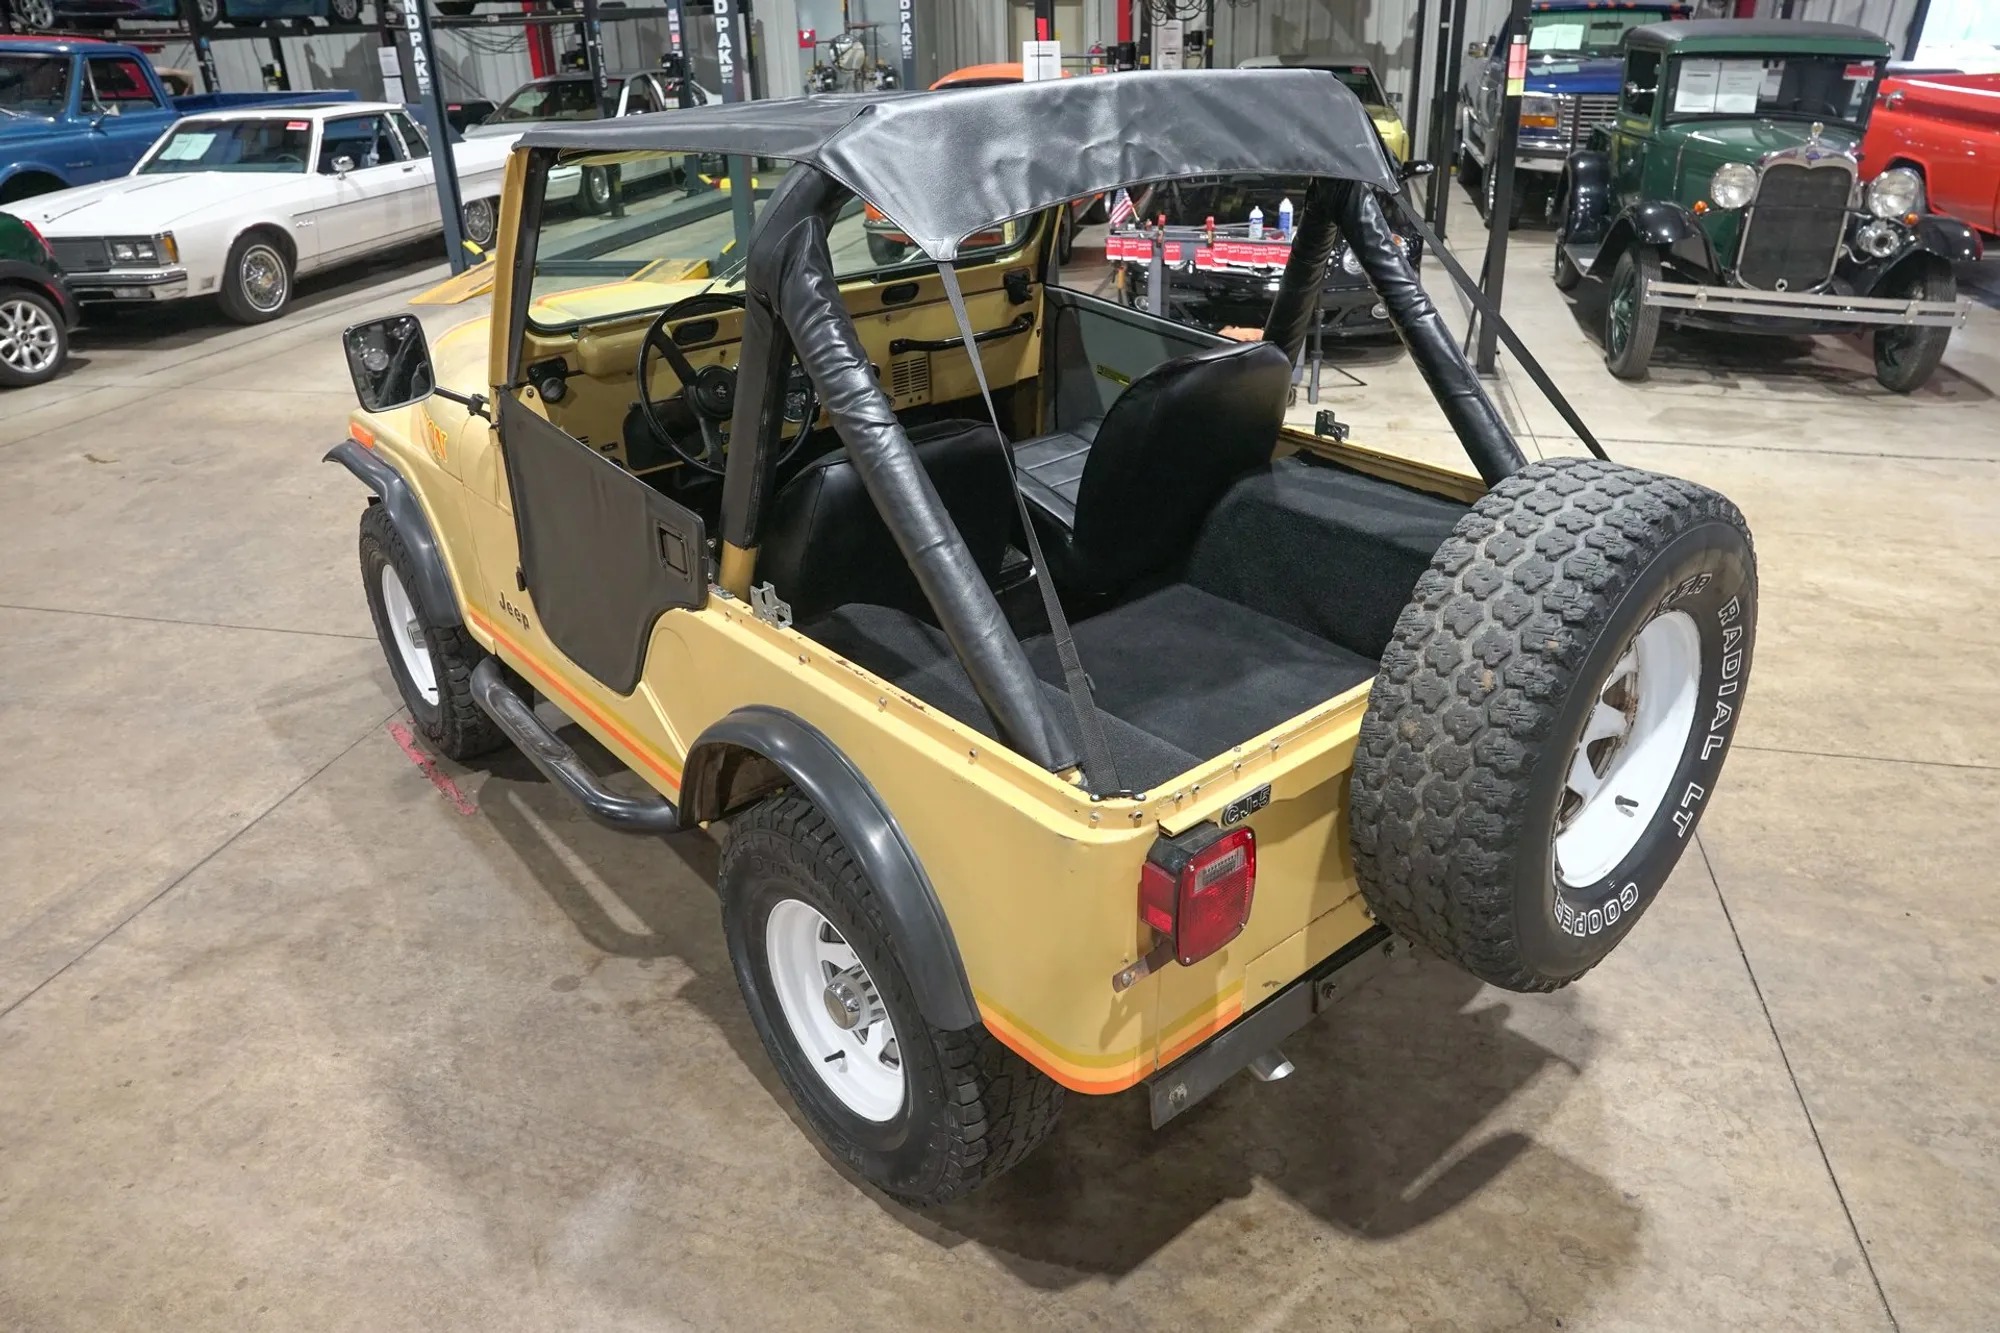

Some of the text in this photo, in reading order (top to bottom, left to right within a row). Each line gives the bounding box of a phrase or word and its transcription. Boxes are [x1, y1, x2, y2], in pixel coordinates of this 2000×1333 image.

[499, 590, 531, 631] Jeep
[1672, 594, 1743, 839] RADIAL LT
[1224, 785, 1270, 826] CJ-5
